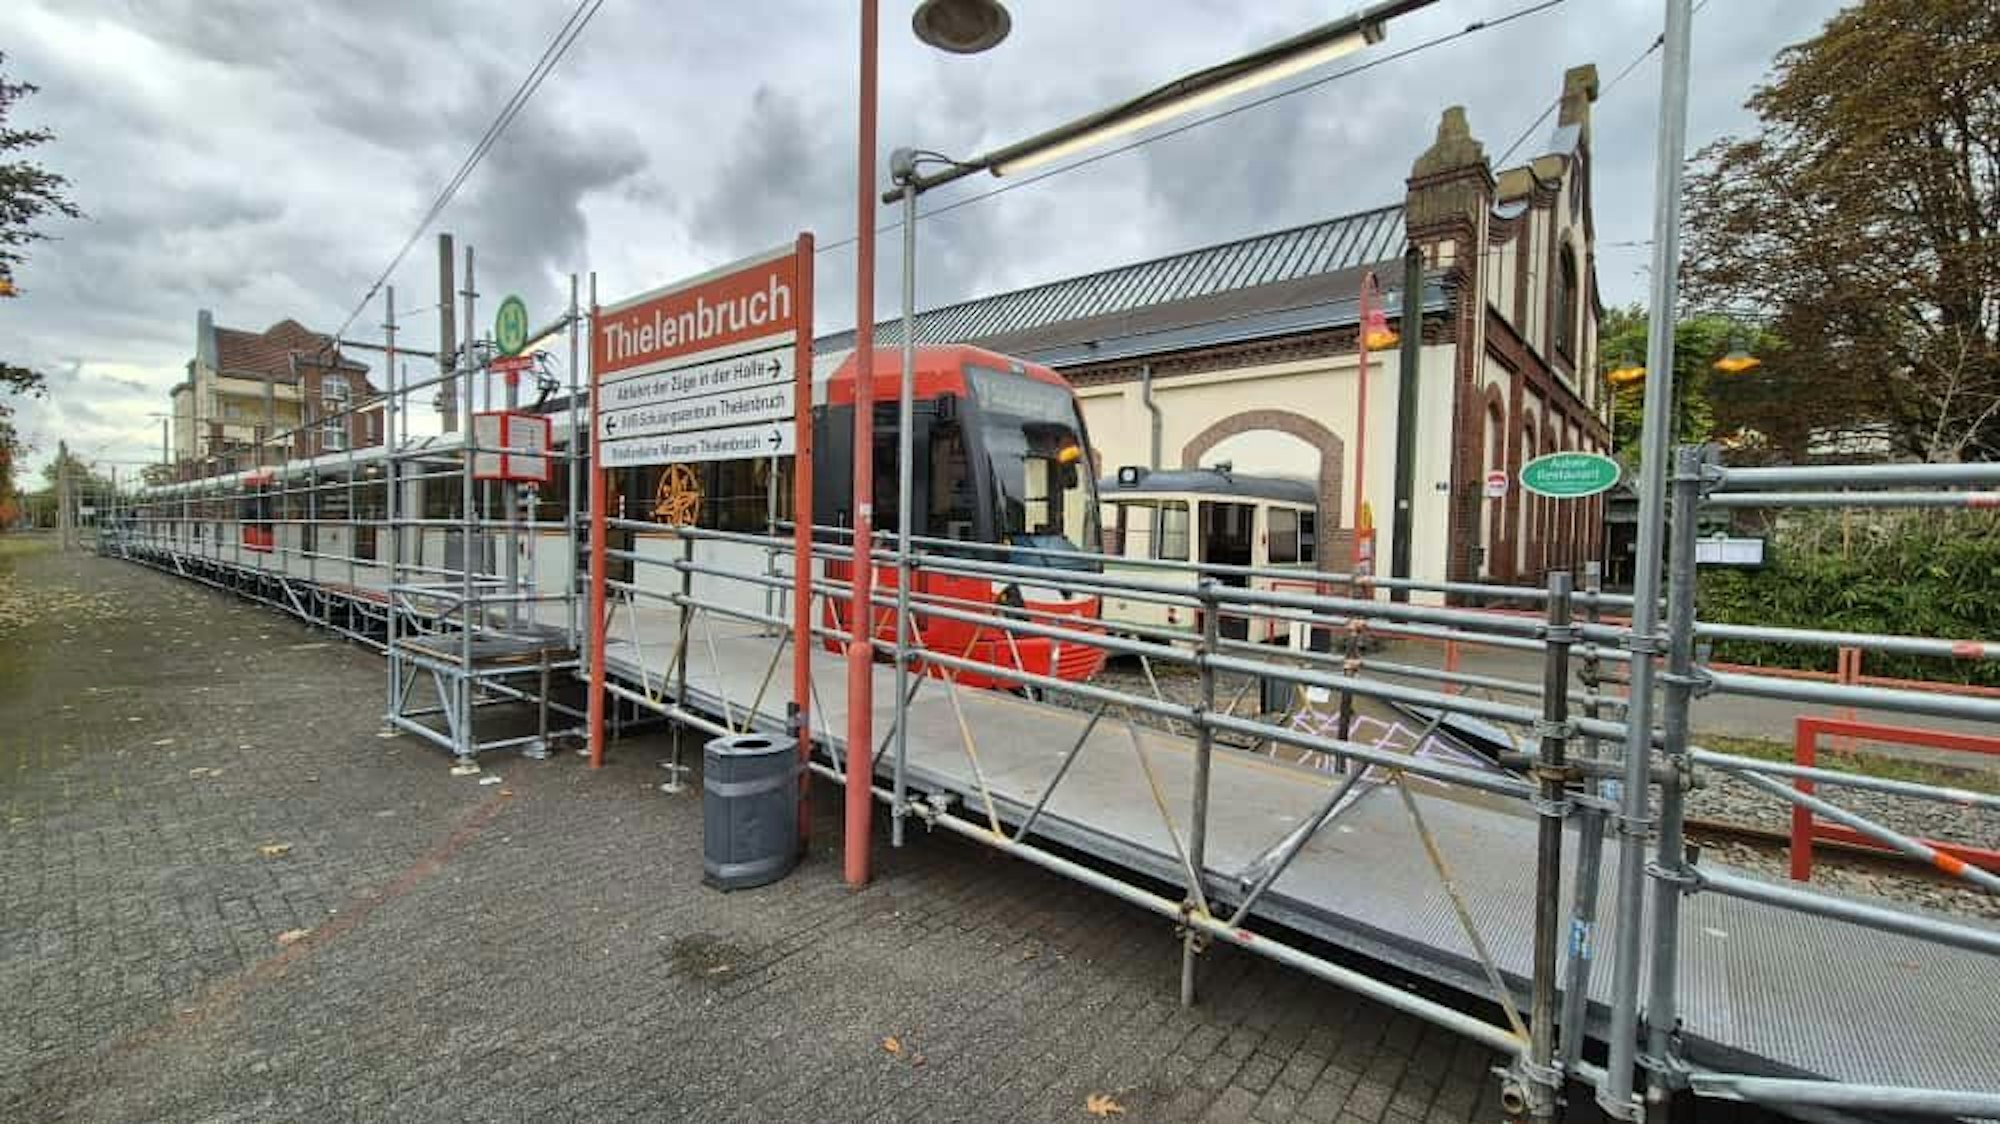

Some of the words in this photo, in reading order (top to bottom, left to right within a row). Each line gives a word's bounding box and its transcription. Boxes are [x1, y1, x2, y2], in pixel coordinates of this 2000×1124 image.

[503, 310, 522, 343] H
[603, 273, 791, 363] Thielenbruch
[653, 380, 669, 396] der
[671, 374, 697, 392] Züge
[712, 367, 729, 385] der
[733, 359, 765, 381] Halle
[720, 393, 785, 417] Thielenbruch
[700, 433, 761, 453] Thielenbruch
[1537, 465, 1599, 482] Restaurant
